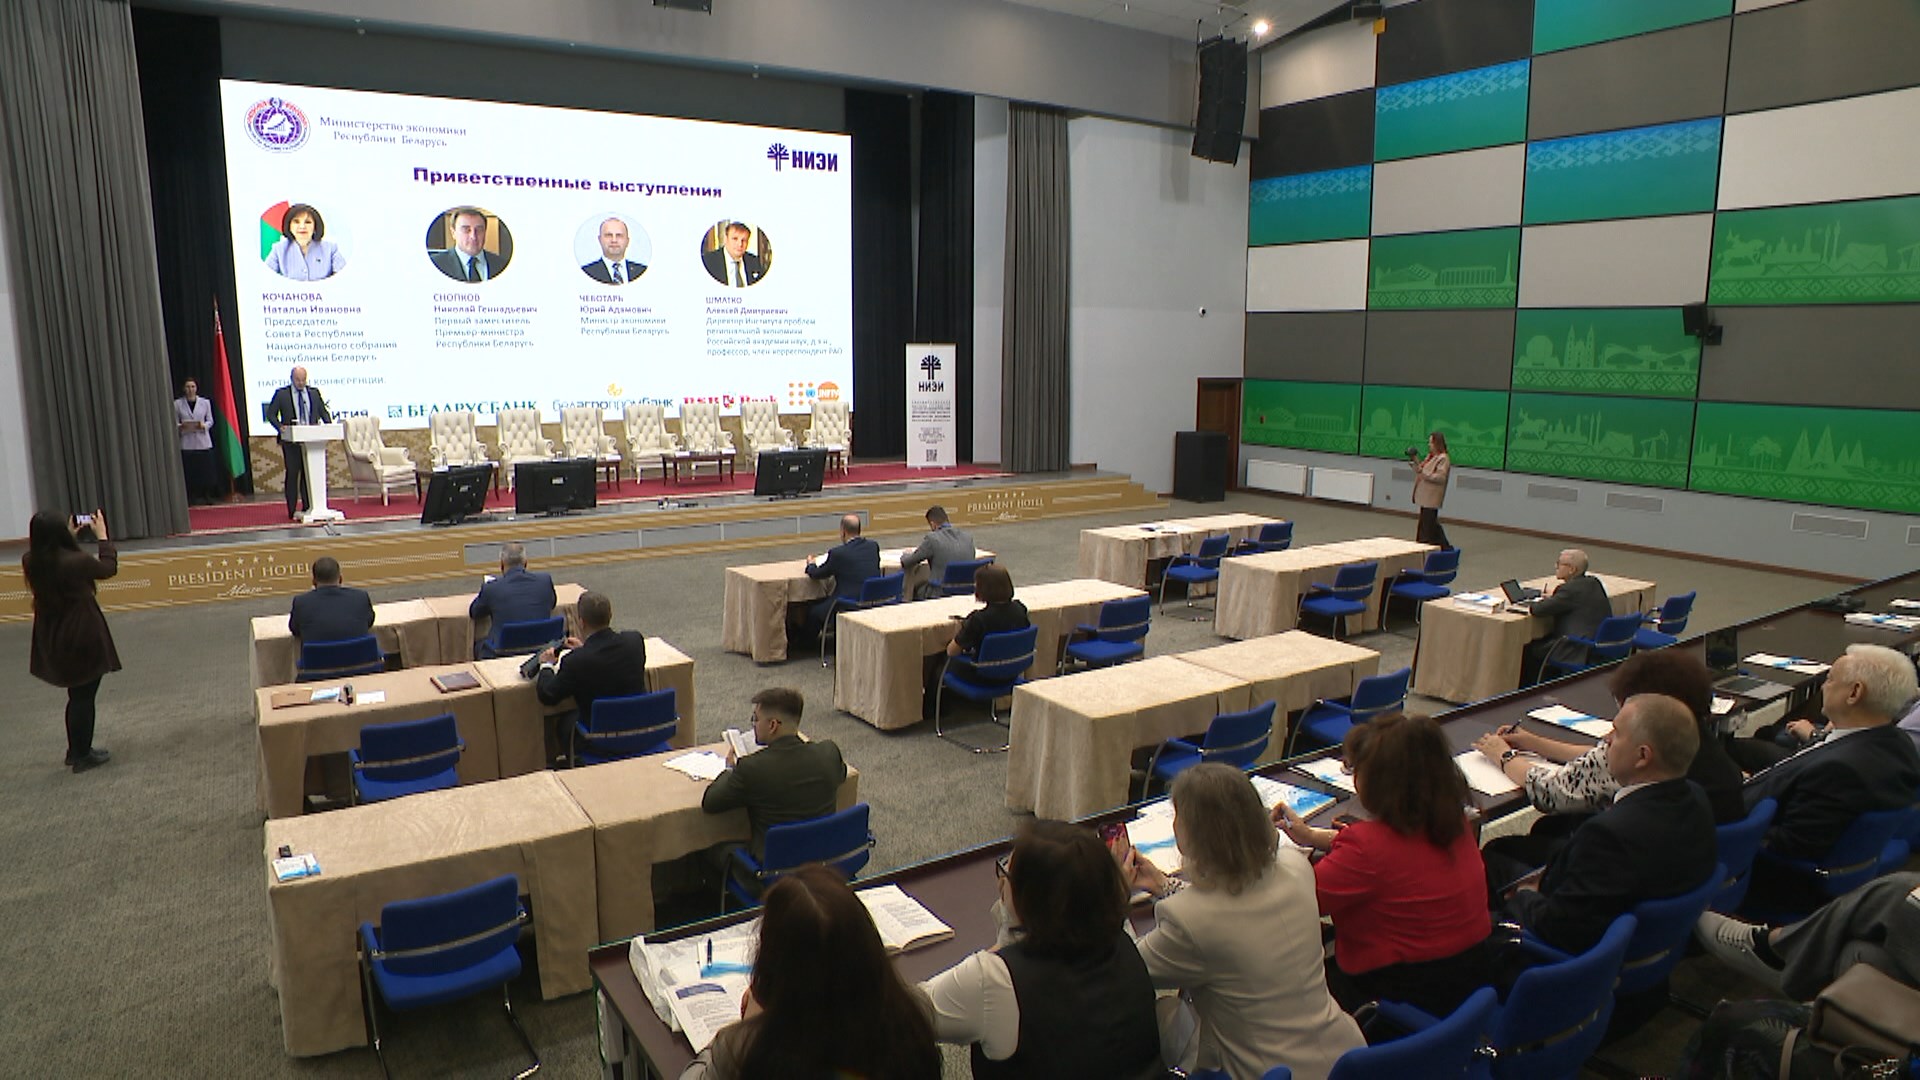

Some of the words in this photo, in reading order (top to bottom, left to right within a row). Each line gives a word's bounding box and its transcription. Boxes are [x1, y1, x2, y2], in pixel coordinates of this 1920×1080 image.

[320, 116, 403, 131] Министерство
[406, 124, 467, 136] экономики
[334, 131, 396, 144] Республики
[402, 135, 448, 148] Беларусь
[791, 149, 839, 172] НИЭИ
[413, 166, 591, 190] Приветственные
[598, 181, 722, 198] выступления
[262, 292, 323, 302] КОЧАНОВА
[433, 292, 480, 302] СНОПКОВ
[705, 296, 743, 305] ШМАТКО
[263, 305, 307, 314] Наталья
[310, 305, 362, 314] Ивановна
[434, 305, 475, 314] Николай
[478, 305, 538, 315] Геннадьевич
[580, 305, 606, 314] Юрий
[264, 317, 338, 327] Председатель
[265, 329, 301, 339] Совета
[304, 329, 365, 340] Республики
[266, 342, 347, 352] Национального
[349, 341, 398, 351] собрания
[267, 353, 328, 363] Республики
[919, 381, 944, 392] НИЭИ
[168, 566, 256, 587] PRESIDENT
